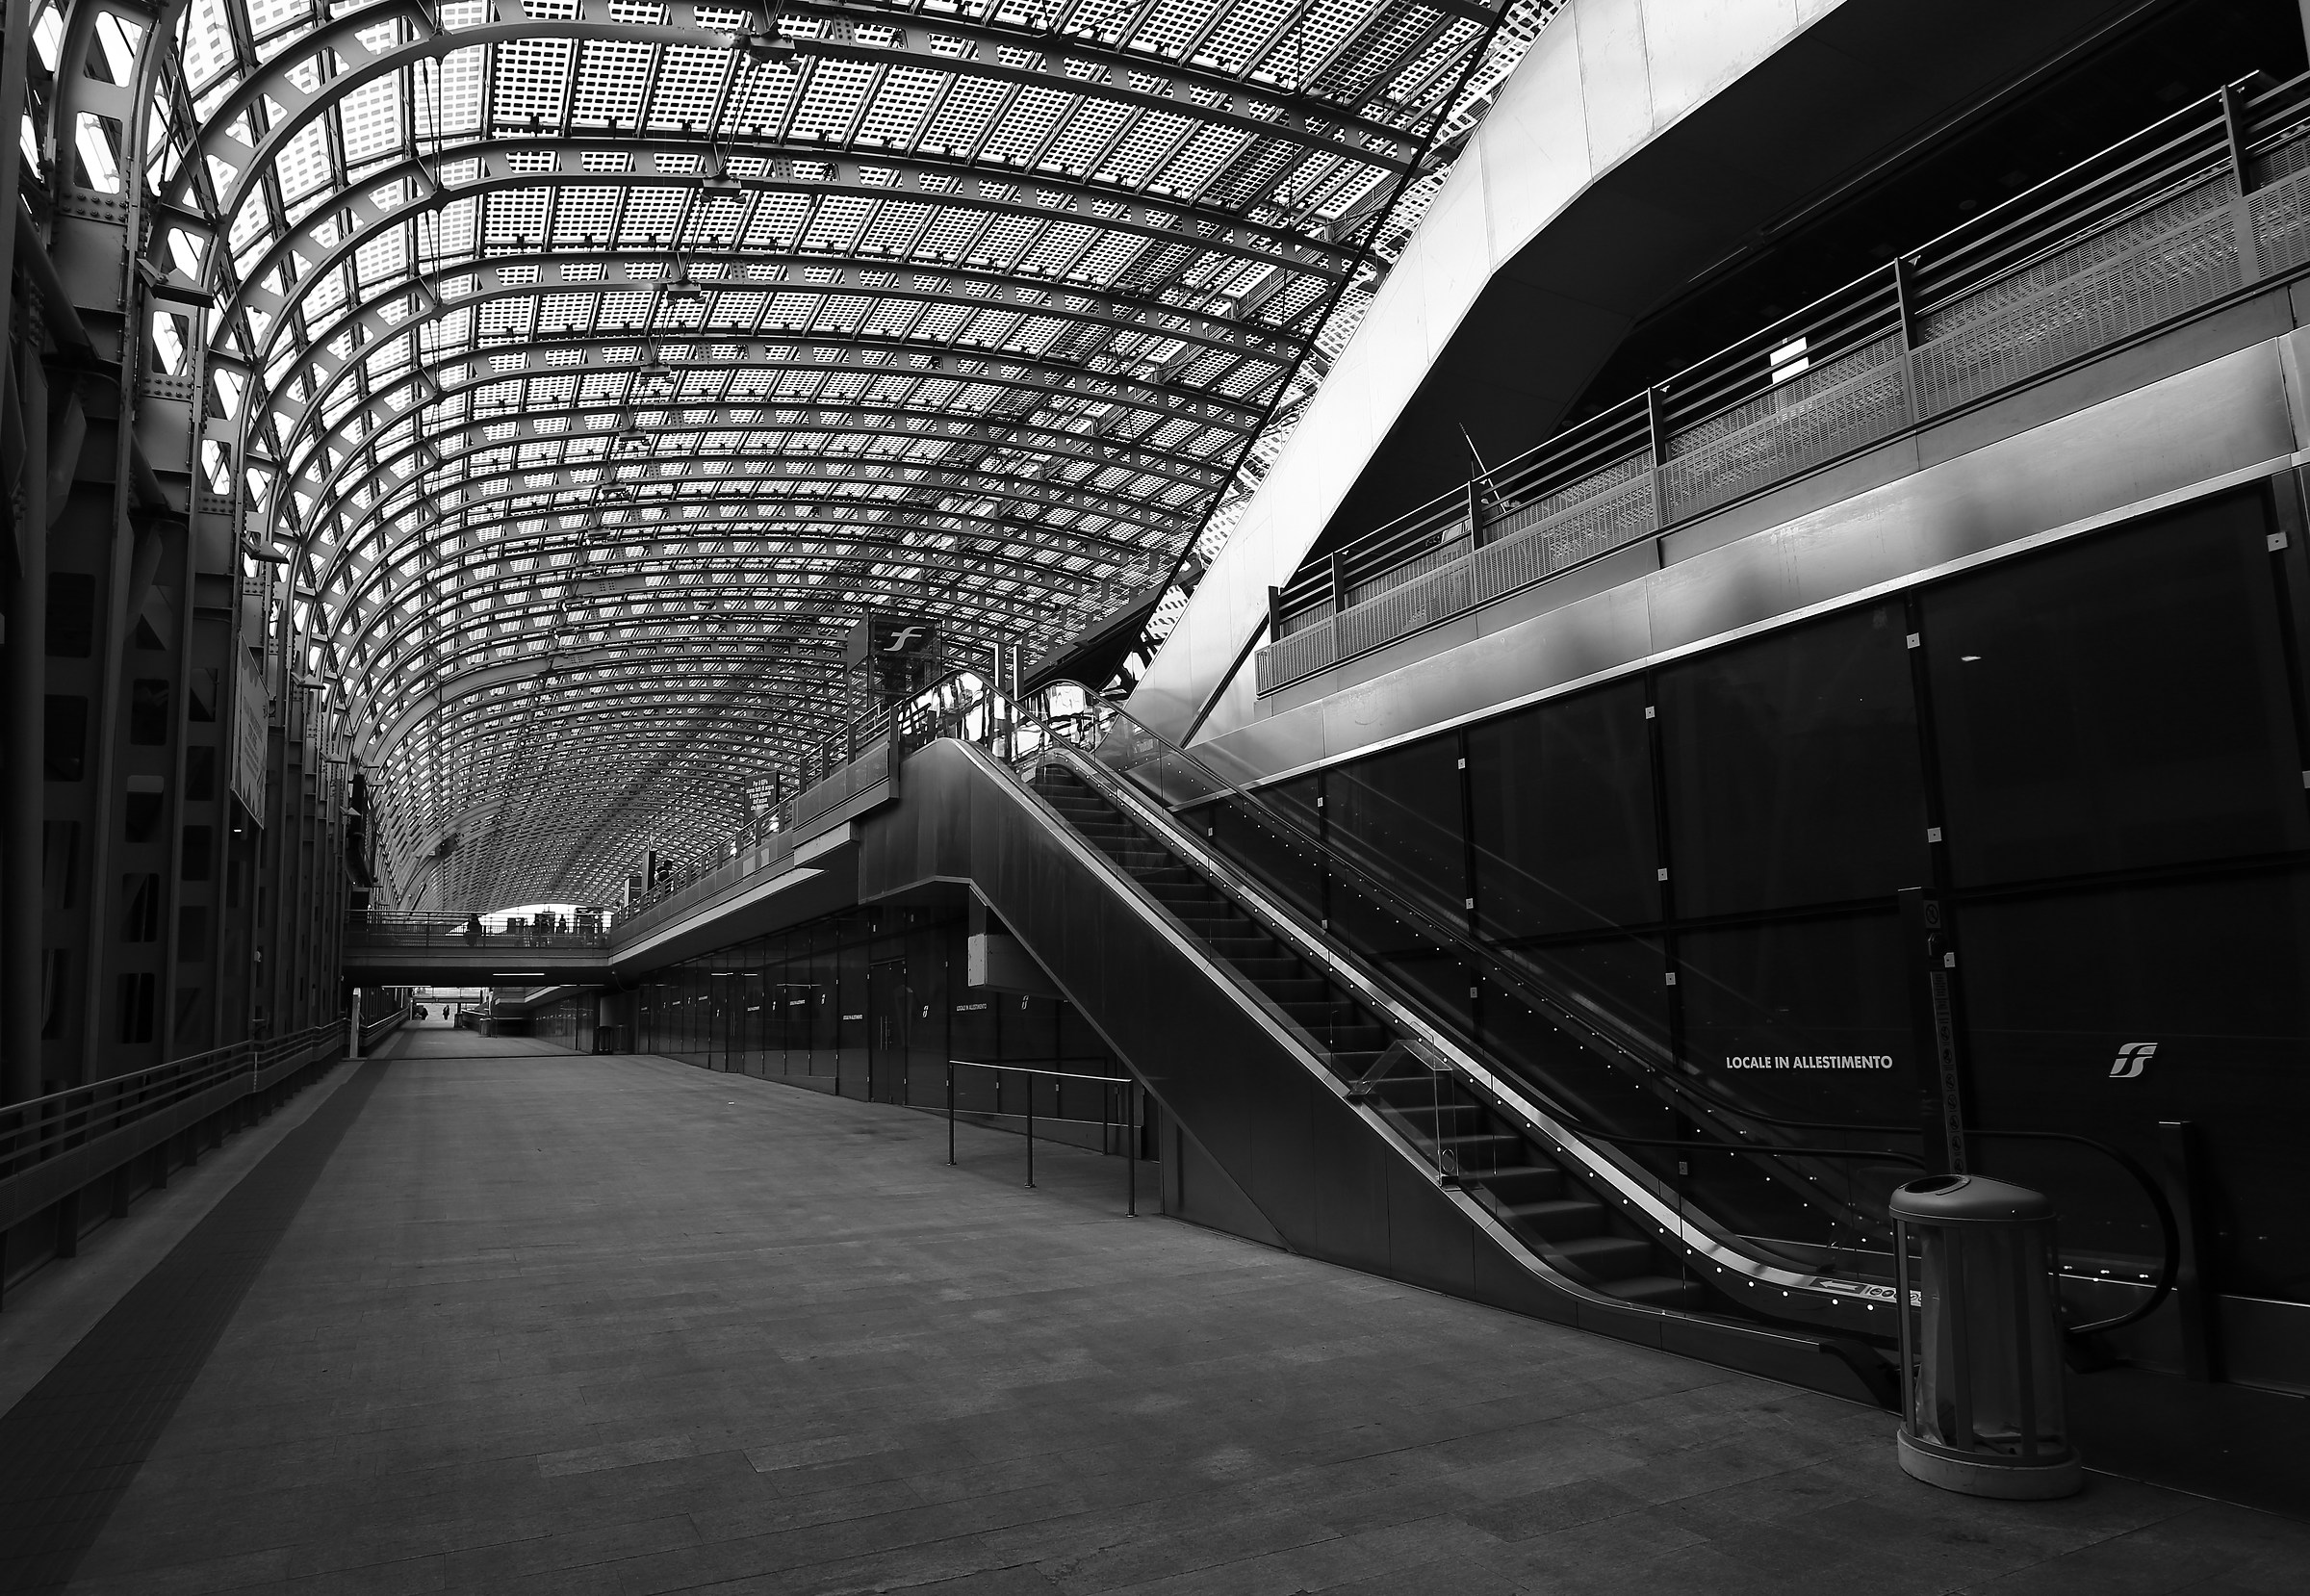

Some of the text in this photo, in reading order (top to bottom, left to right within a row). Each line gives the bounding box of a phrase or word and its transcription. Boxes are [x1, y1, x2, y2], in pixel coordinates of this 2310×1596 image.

[1726, 1055, 1893, 1069] LOCALE IN ALLESTIMENTO
